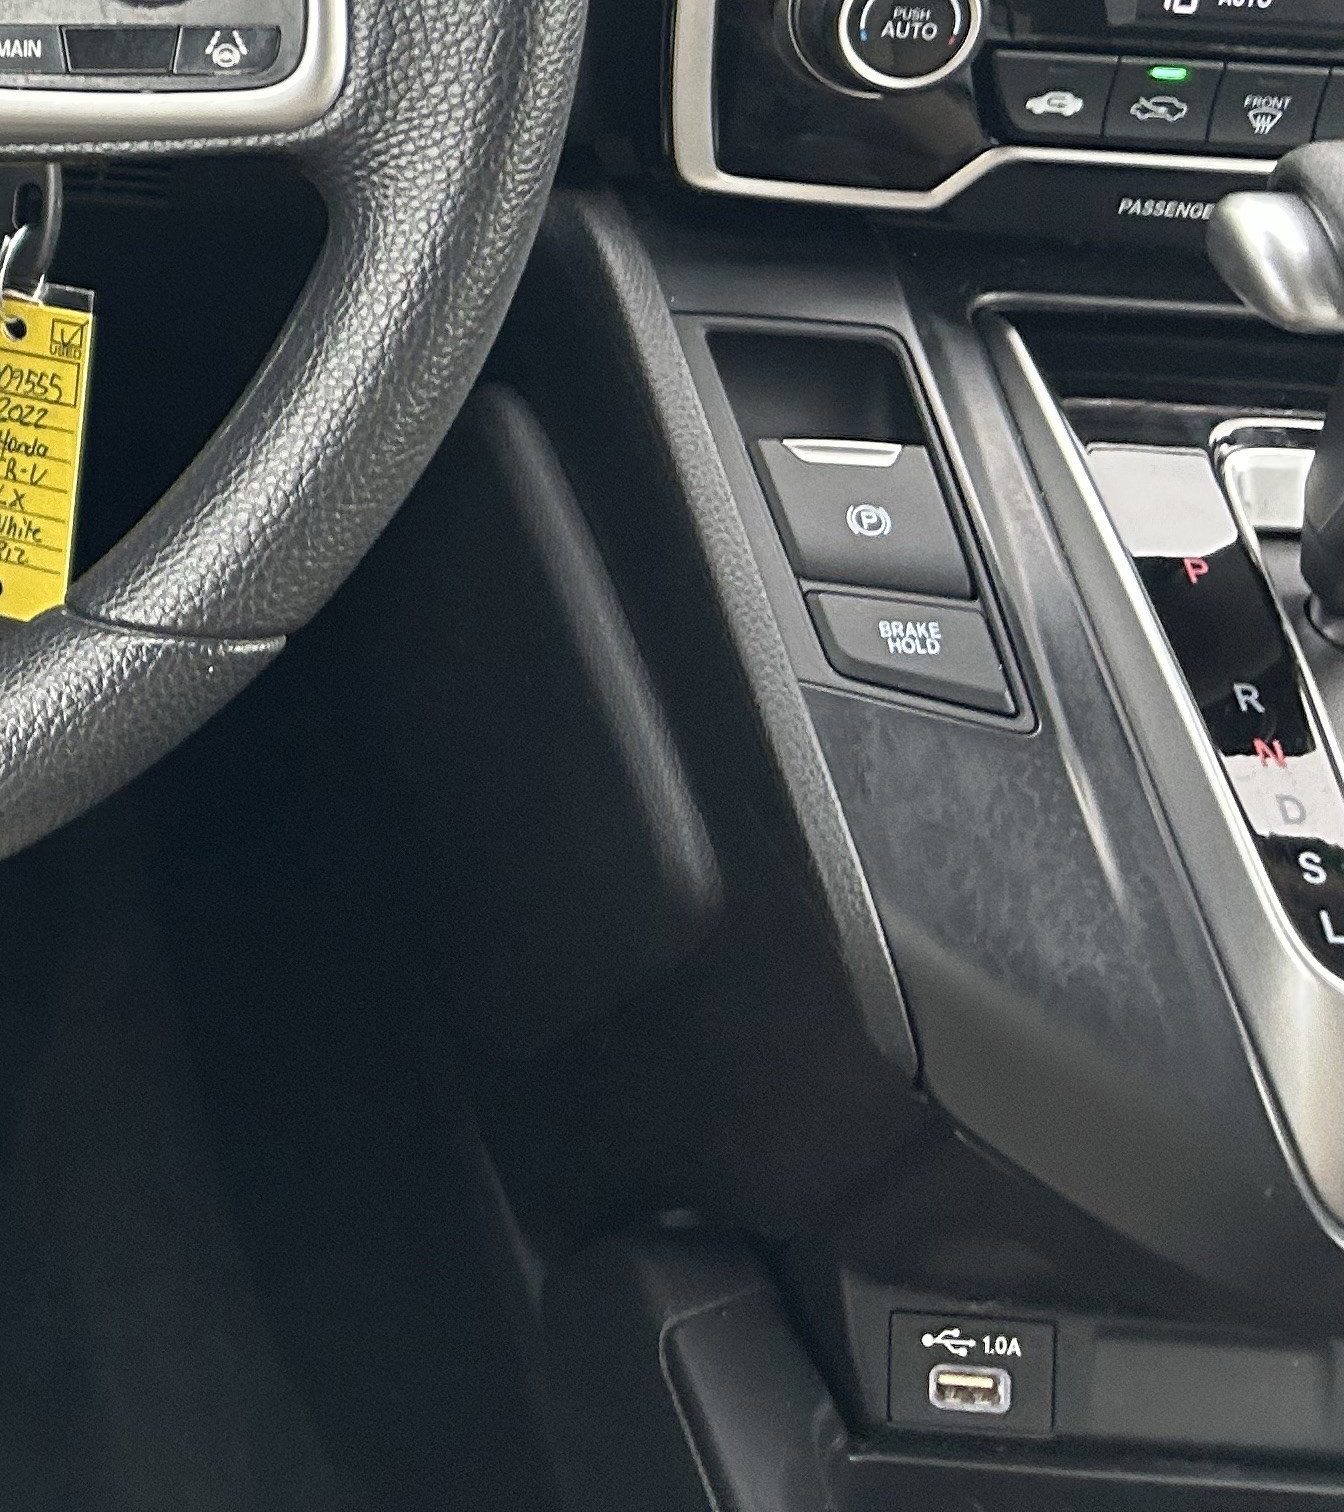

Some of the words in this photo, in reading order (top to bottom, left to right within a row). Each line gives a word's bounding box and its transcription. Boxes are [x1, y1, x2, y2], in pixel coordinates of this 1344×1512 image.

[893, 6, 931, 22] PUSH
[880, 19, 939, 42] AUTO
[1243, 95, 1290, 111] FRONT
[1184, 557, 1209, 584] P
[879, 621, 942, 640] BRAKE
[888, 635, 941, 656] HOLD
[1233, 683, 1266, 714] R
[1253, 737, 1287, 768] N
[1275, 794, 1307, 825] D
[1298, 850, 1327, 885] S
[981, 1334, 1022, 1358] 1.0A
